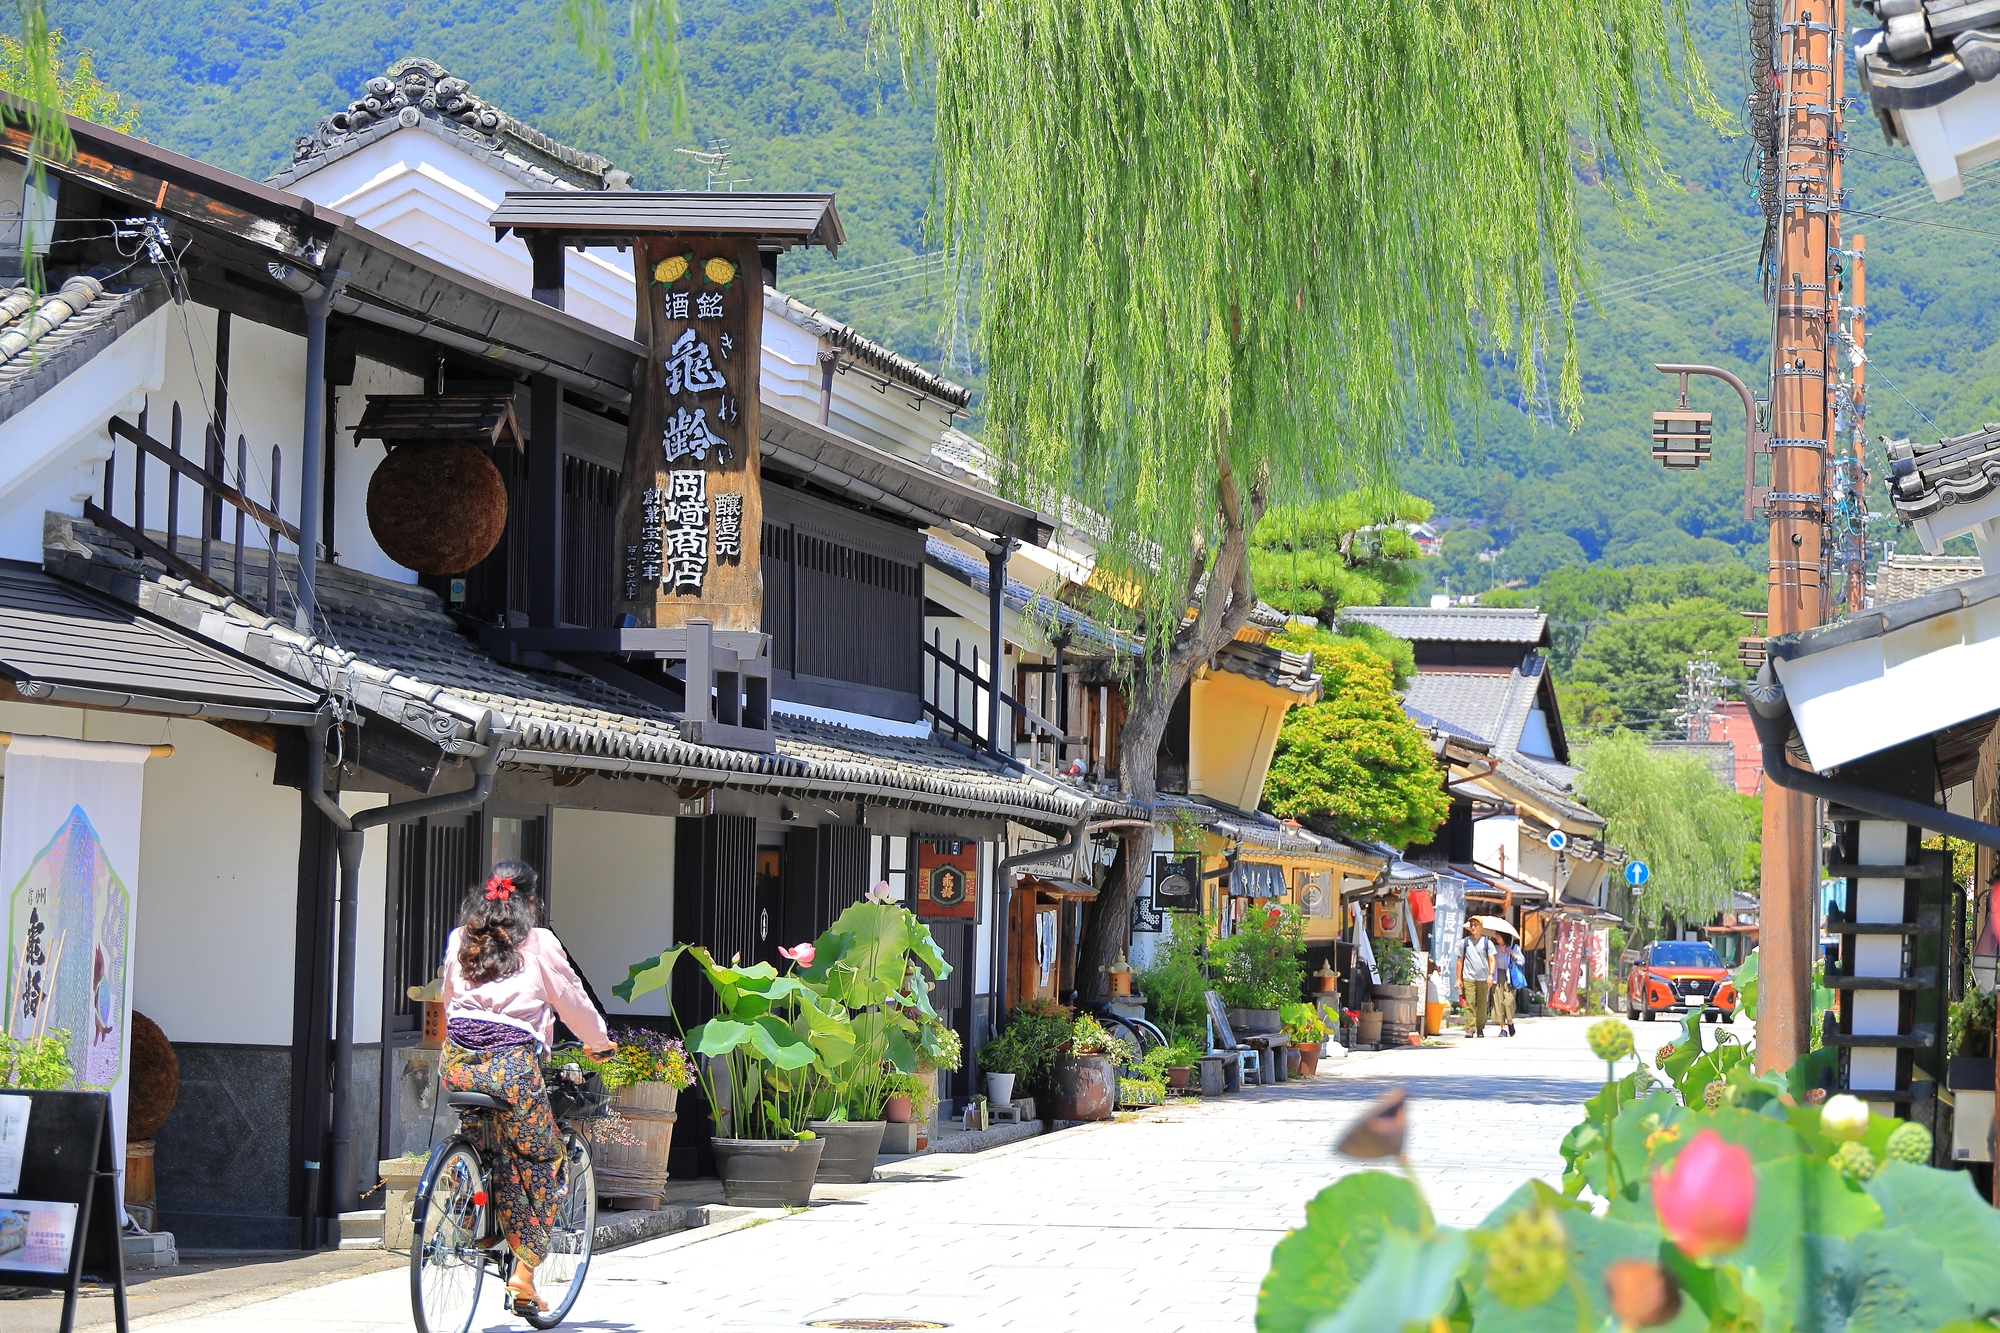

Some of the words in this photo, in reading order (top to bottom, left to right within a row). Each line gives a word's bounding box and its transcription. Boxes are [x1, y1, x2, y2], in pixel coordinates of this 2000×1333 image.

[642, 487, 662, 581] 創業宝永三年
